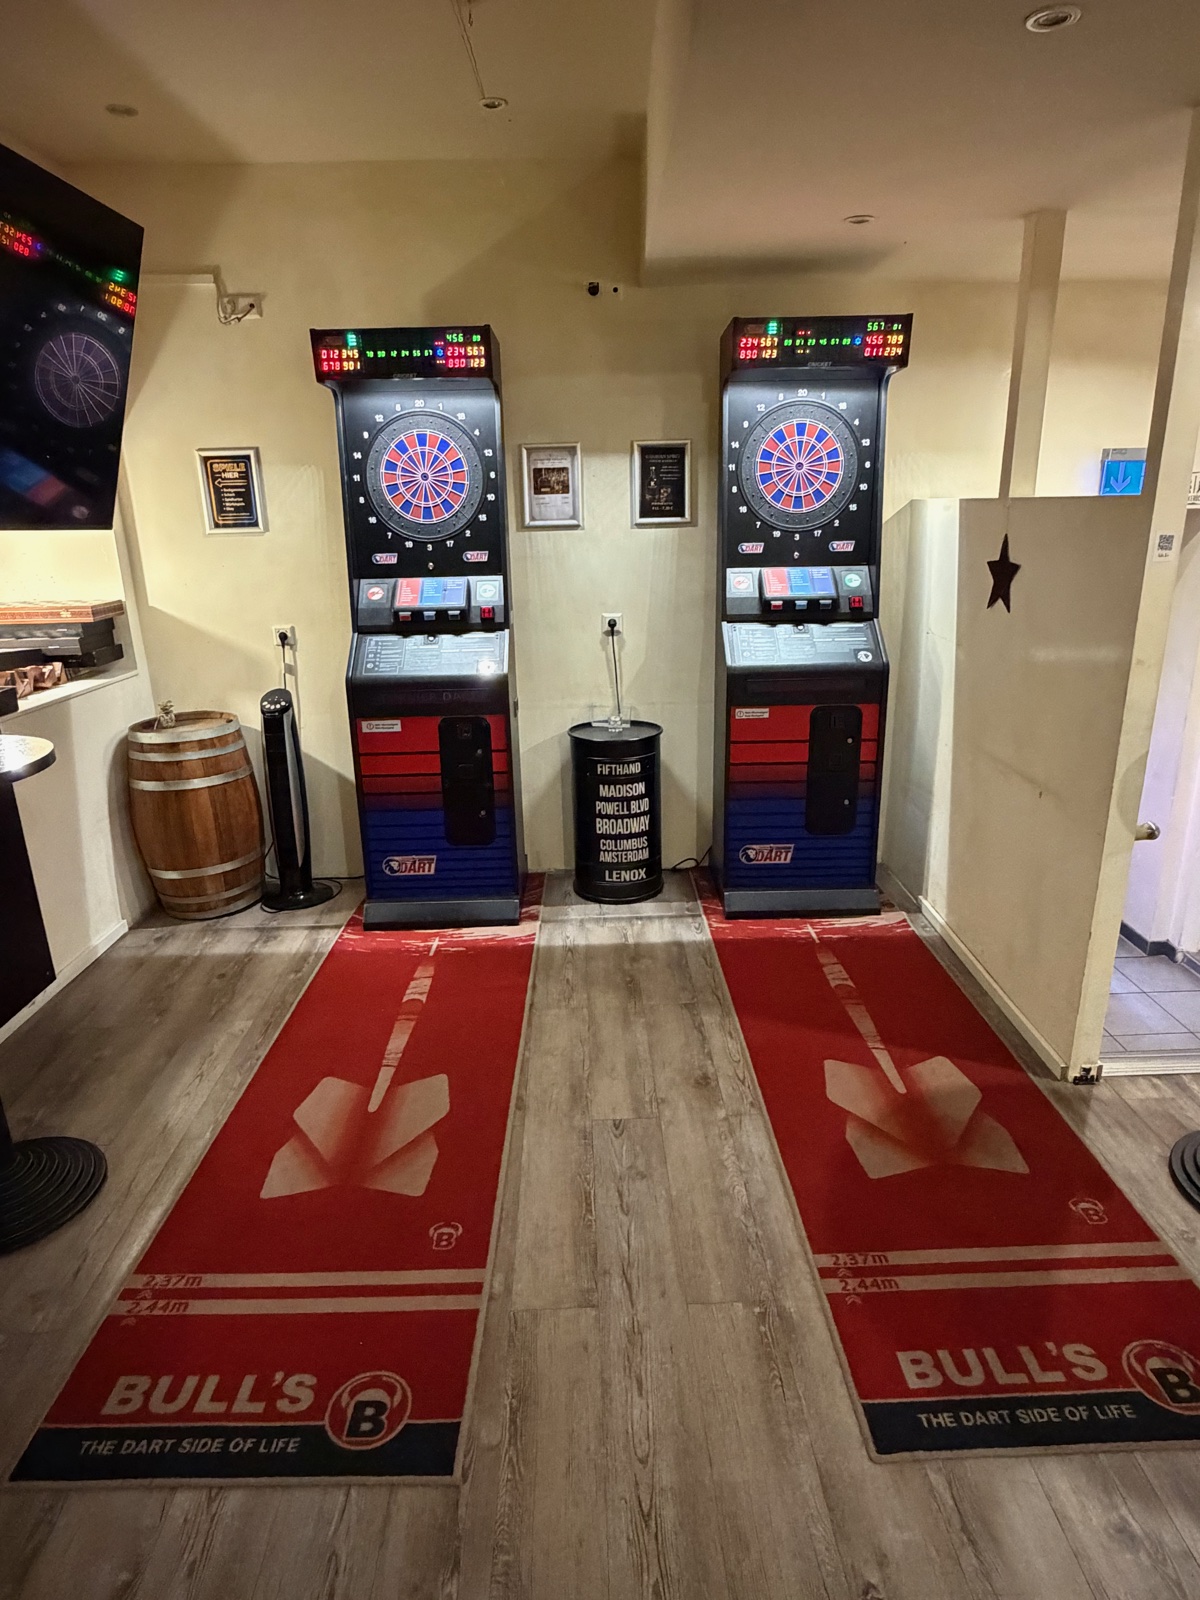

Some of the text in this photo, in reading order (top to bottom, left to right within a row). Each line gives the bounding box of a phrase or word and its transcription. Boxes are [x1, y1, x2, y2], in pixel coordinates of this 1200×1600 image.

[867, 322, 884, 331] 567
[446, 334, 463, 342] 456
[740, 338, 778, 347] 234 567
[866, 335, 903, 344] 456 789
[322, 349, 358, 358] 012 345
[447, 346, 484, 356] 234 567
[762, 350, 777, 358] 123
[884, 347, 902, 356] 234
[323, 361, 340, 370] 678
[471, 358, 485, 367] 123
[598, 762, 641, 775] FIFTHAND
[599, 782, 645, 797] MADISON
[596, 798, 649, 815] POWELL BLVD
[596, 815, 650, 834] BROADWAY
[600, 836, 648, 850] COLUMBUS
[599, 848, 649, 862] AMSTERDAM
[755, 848, 791, 861] DART
[400, 860, 434, 873] DART
[605, 868, 646, 882] LENOX
[896, 1341, 1108, 1390] BULL'S
[100, 1371, 318, 1415] BULL'S
[917, 1404, 1136, 1428] THE DART SIDE OF LIFE
[81, 1437, 301, 1455] THE DART SIDE OF LIFE
